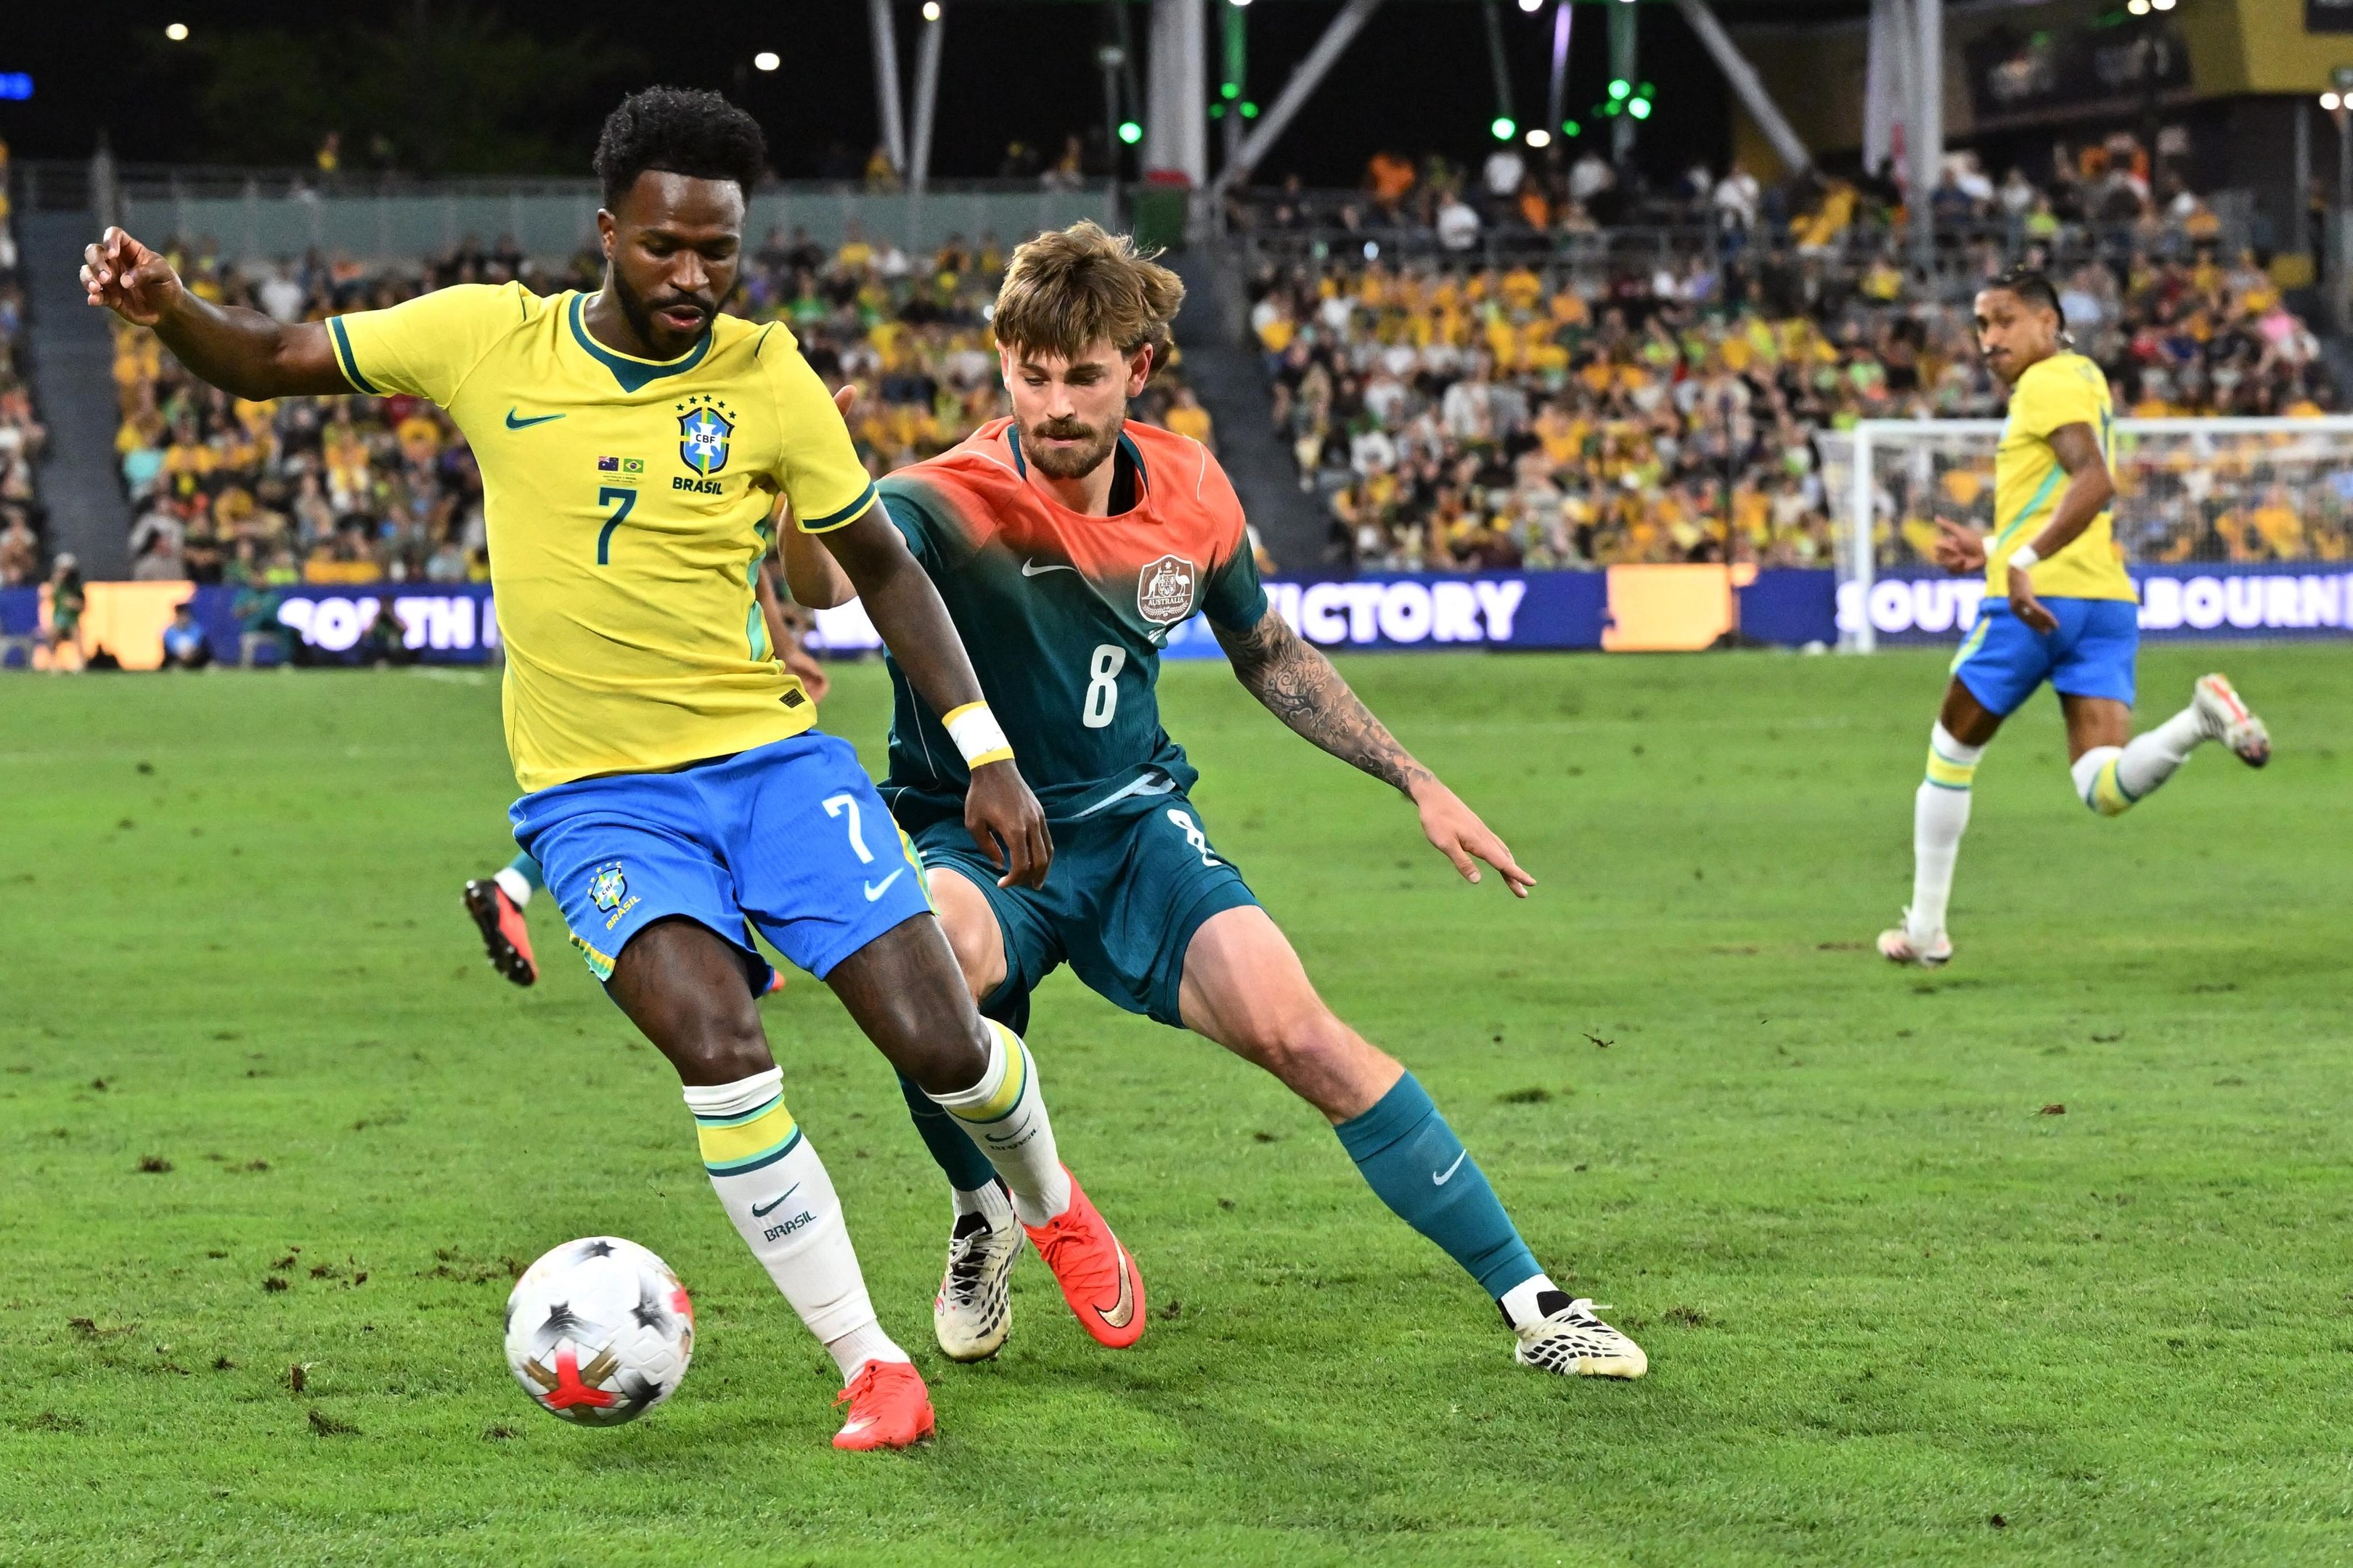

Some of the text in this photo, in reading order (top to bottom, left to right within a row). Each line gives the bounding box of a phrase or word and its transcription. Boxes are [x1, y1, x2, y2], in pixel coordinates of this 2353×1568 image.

[696, 433, 716, 444] CBF
[672, 476, 723, 495] BRASIL
[597, 486, 637, 565] 7
[277, 596, 475, 650] SOTH
[1148, 597, 1184, 606] AUSTRALIA
[1261, 581, 1526, 644] ICTORY
[1835, 579, 1986, 633] SOUT
[1082, 643, 1127, 728] 8
[822, 793, 875, 865] 7
[602, 882, 613, 896] CBF
[605, 895, 642, 931] BRASIL
[764, 1210, 817, 1242] BRASIL
